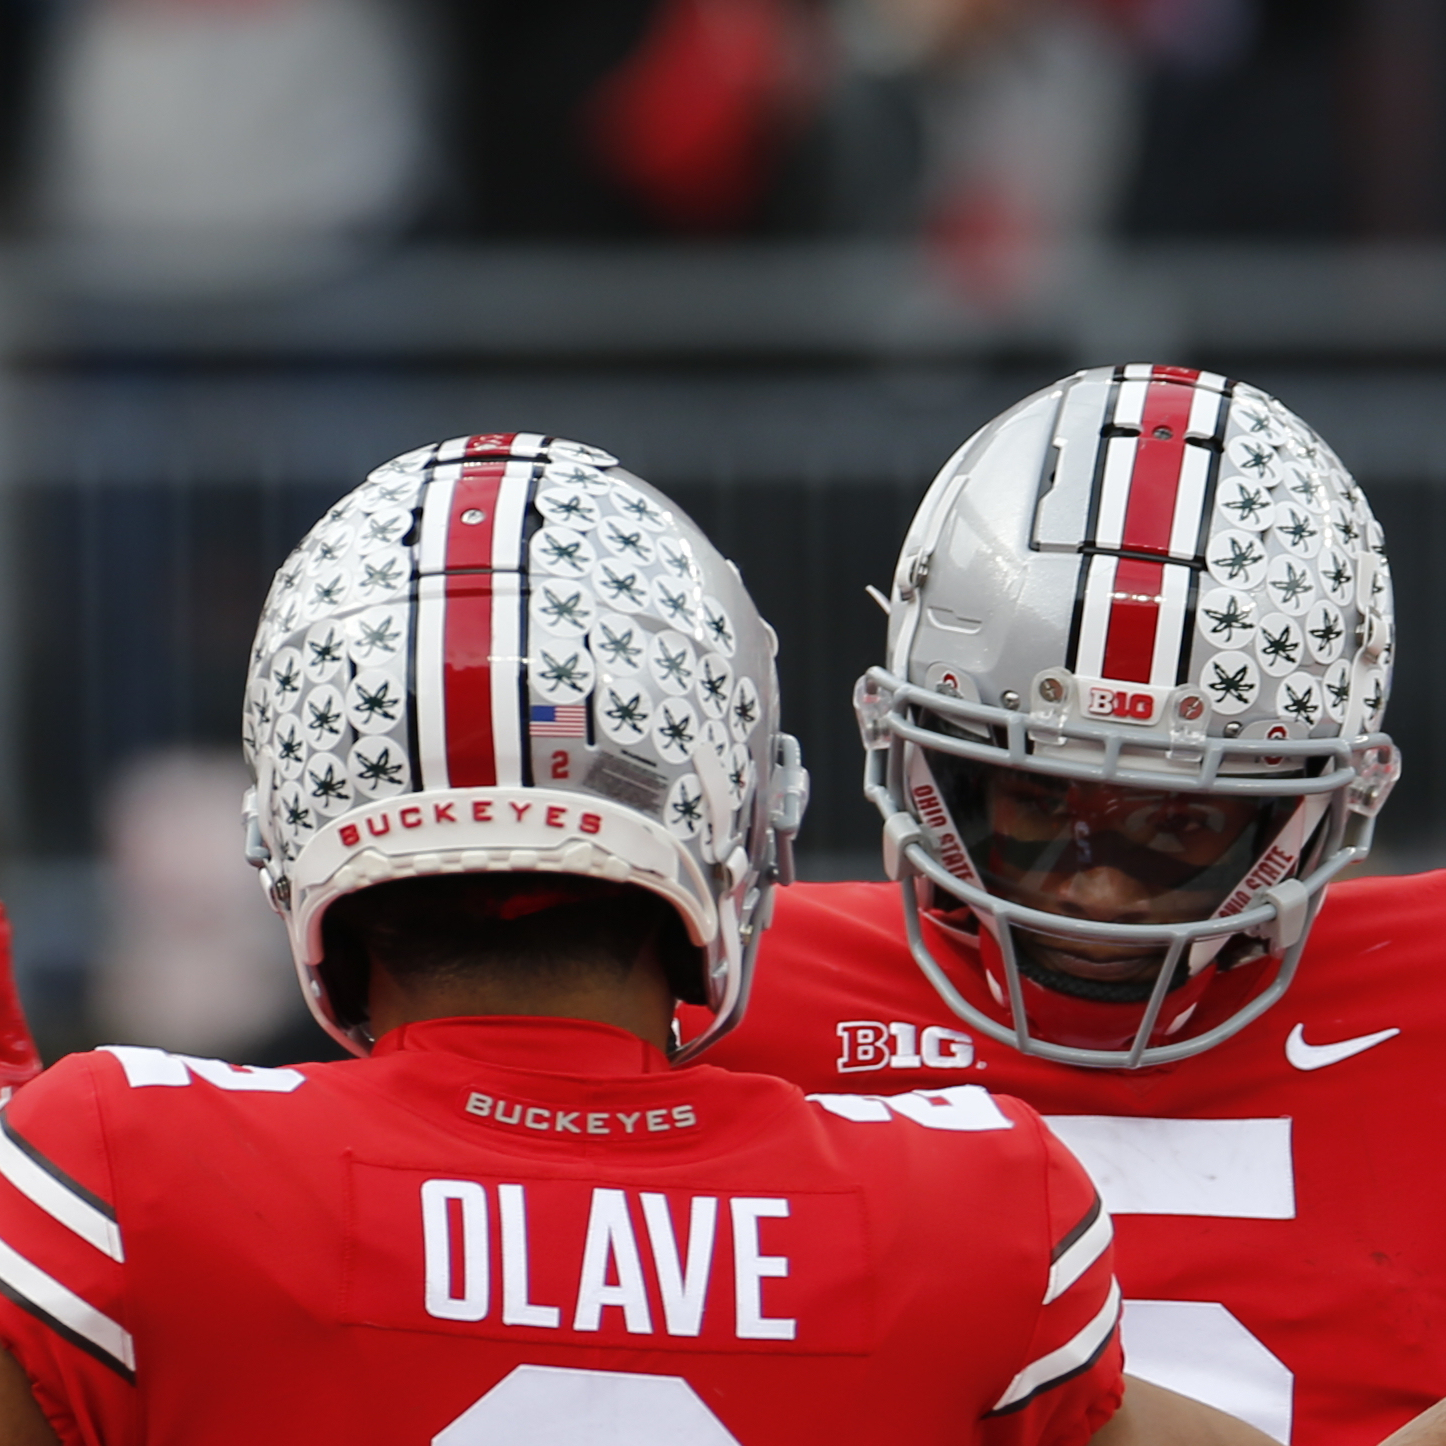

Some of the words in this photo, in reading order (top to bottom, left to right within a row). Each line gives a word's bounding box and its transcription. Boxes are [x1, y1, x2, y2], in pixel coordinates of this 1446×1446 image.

[551, 750, 569, 779] 2
[338, 800, 604, 848] BUCKEYES
[914, 784, 948, 829] OHIO
[1245, 845, 1295, 891] STATE
[465, 1091, 697, 1135] BUCKEYES
[420, 1178, 797, 1340] OLAVE
